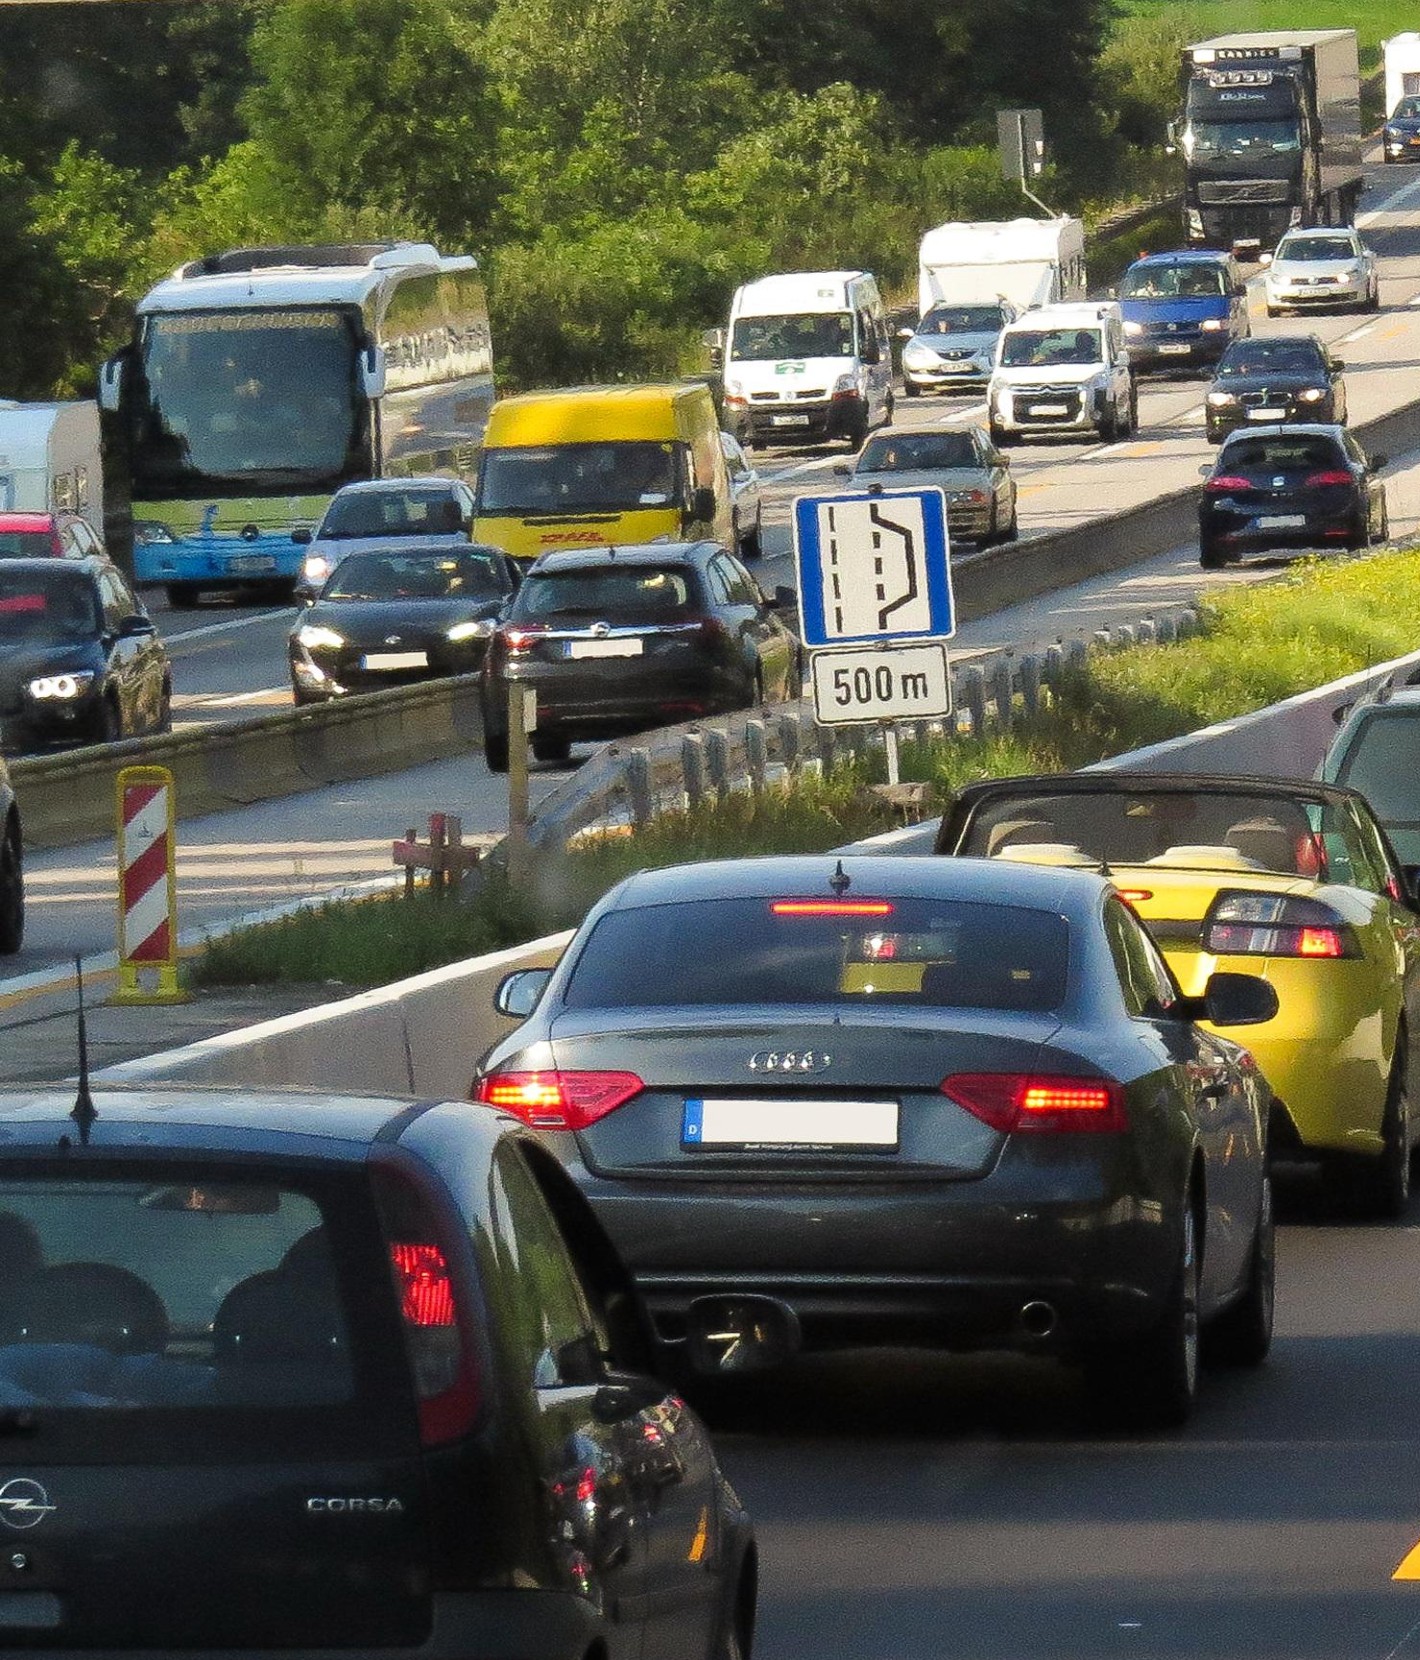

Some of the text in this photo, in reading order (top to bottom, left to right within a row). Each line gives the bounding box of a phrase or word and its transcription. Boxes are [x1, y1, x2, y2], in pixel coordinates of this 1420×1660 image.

[833, 665, 929, 706] 500 m
[307, 1498, 404, 1511] CORSA
